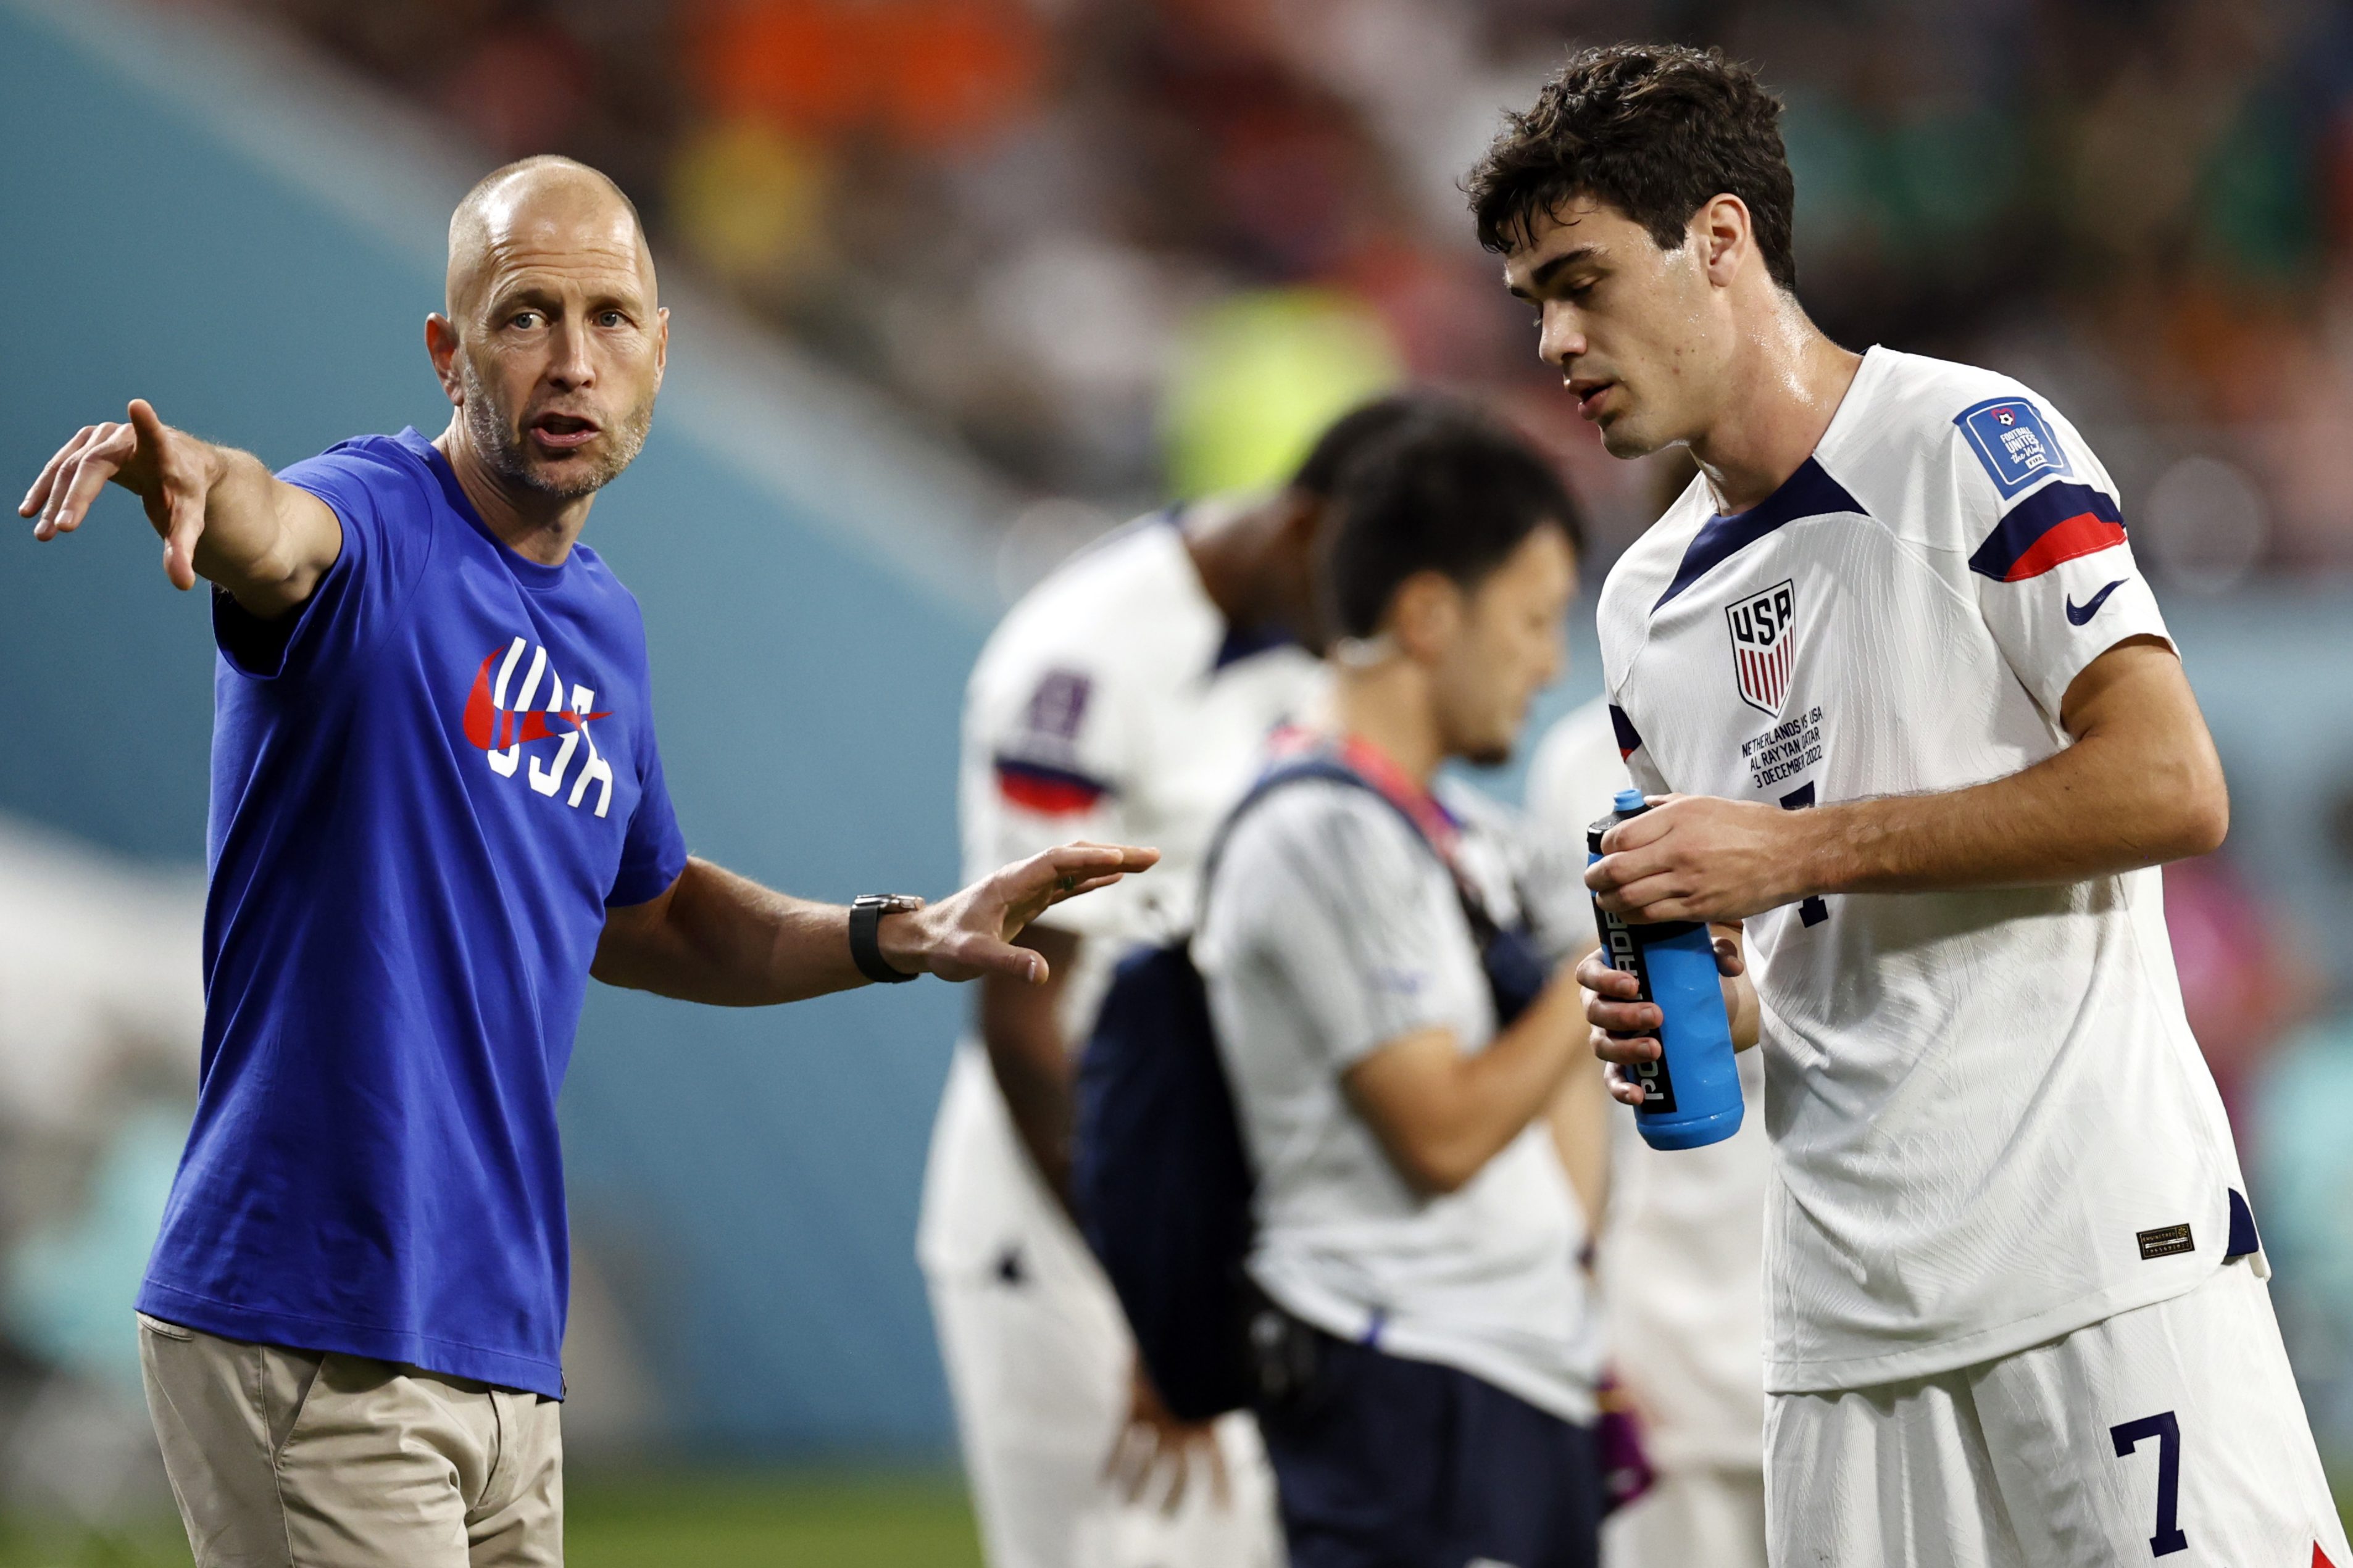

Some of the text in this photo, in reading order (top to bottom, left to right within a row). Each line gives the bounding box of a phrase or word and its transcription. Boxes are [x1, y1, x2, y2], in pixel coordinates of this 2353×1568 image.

[2000, 426, 2033, 443] FOOTBALL
[2005, 434, 2039, 454] UNITES
[2029, 457, 2042, 465] FIFA
[1733, 589, 1791, 645] USA
[1742, 719, 1801, 758] NETHERLANDS
[1809, 706, 1823, 724] USA
[1751, 756, 1761, 772] AL
[1801, 726, 1820, 749] QATAR
[1754, 744, 1822, 789] 3 DECEMBER 2022
[2109, 1410, 2188, 1558] 7
